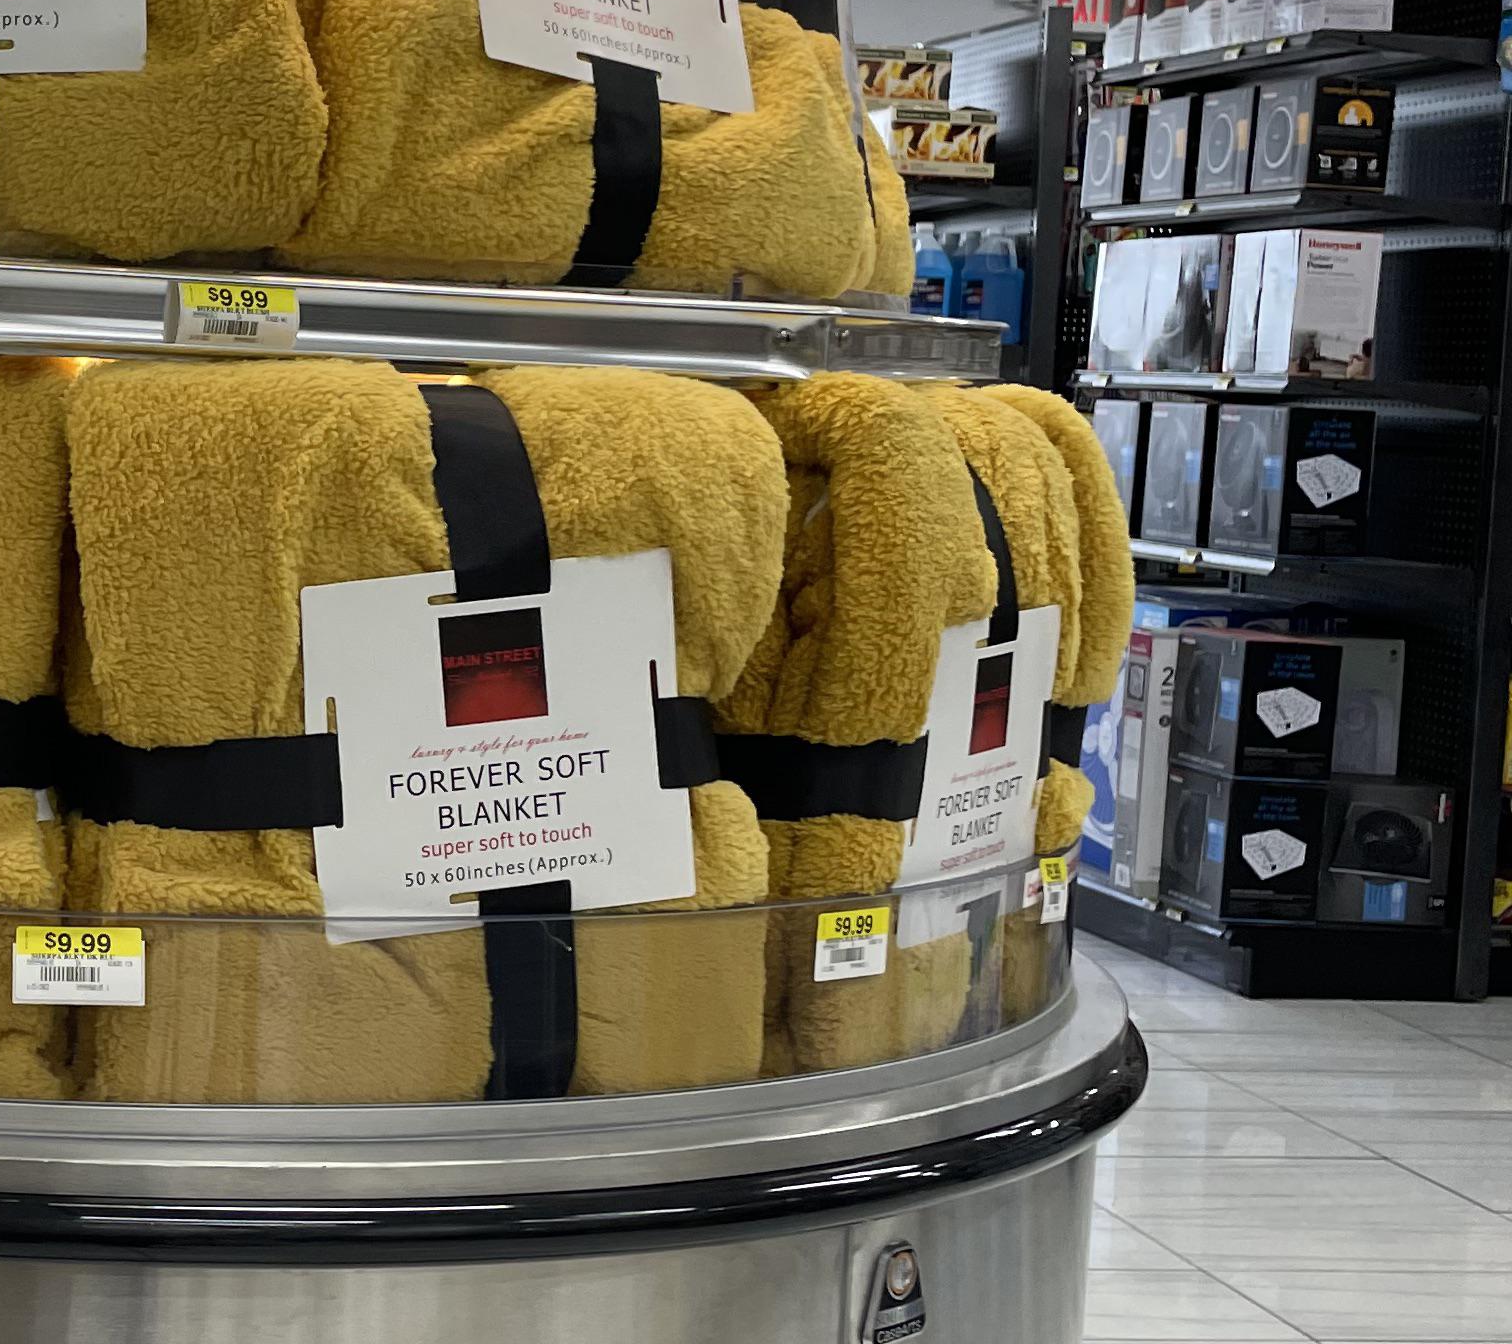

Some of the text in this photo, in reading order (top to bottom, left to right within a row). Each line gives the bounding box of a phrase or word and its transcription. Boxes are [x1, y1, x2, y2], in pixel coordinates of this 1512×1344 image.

[543, 20, 559, 34] 50
[554, 2, 674, 41] super soft to touch
[1309, 238, 1361, 251] Honeywell
[208, 287, 268, 308] $9.99
[444, 646, 541, 669] MAIN STREET
[389, 750, 610, 799] FOREVER SOFT
[937, 776, 1023, 819] FOREVER SOFT
[439, 791, 567, 830] BLANKET
[952, 812, 1002, 846] BLANKET
[421, 823, 593, 859] super soft to touch
[405, 871, 424, 887] 50
[431, 873, 440, 885] x
[835, 915, 873, 935] $9.99
[45, 932, 111, 954] $9.99
